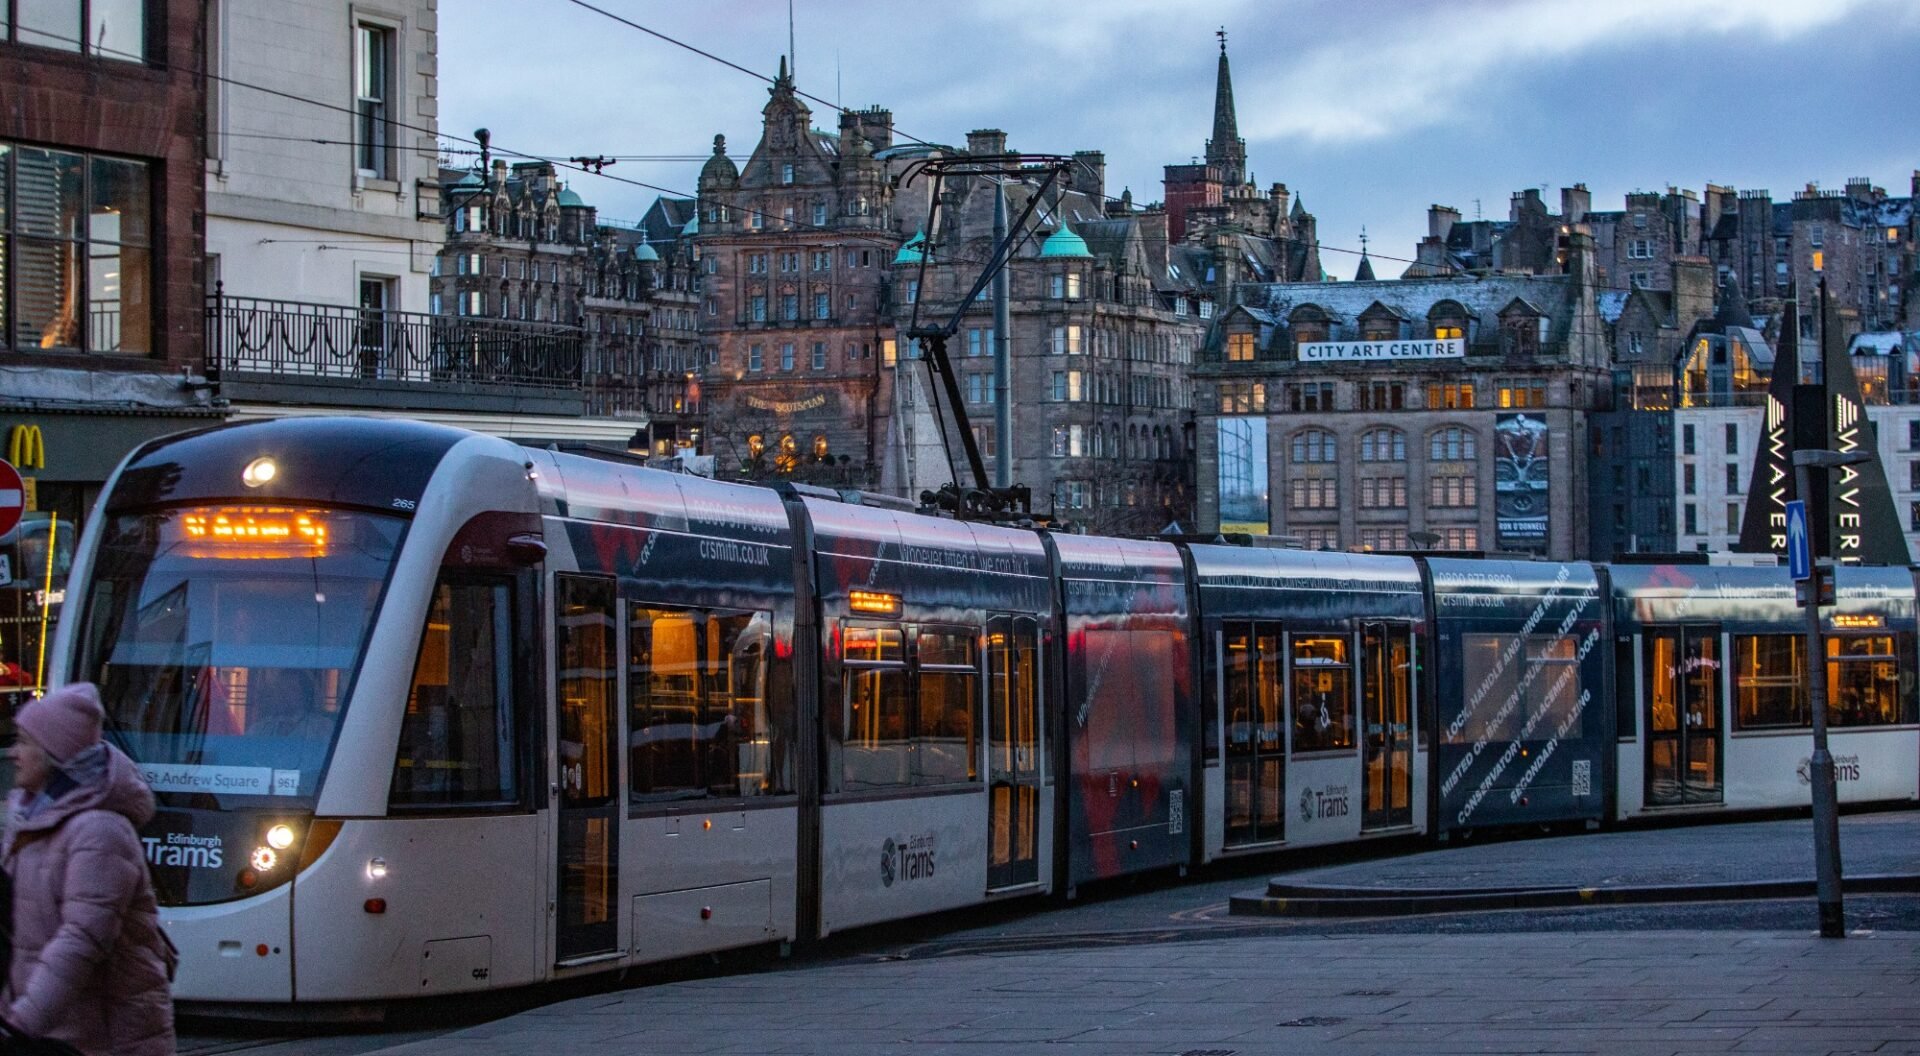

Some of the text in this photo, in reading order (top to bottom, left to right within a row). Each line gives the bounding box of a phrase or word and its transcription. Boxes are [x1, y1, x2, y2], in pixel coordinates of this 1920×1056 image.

[1307, 341, 1457, 358] CITY ART CENTRE
[775, 393, 825, 413] SCOTSMAN
[1769, 427, 1787, 549] WAVER
[392, 498, 416, 510] 265
[700, 539, 769, 566] crsmith.co.uk
[1470, 661, 1504, 710] HANDLE
[1503, 637, 1521, 665] AND
[1519, 609, 1546, 643] HINGE
[1458, 627, 1600, 824] CONSERVATORY REPLACEMENT OOFS
[1441, 752, 1474, 798] MISTED
[1473, 735, 1488, 756] OR
[1486, 692, 1520, 740] BROKEN
[1510, 688, 1591, 804] SECONDARY GLAZING
[146, 771, 259, 788] St Andrew Square
[277, 778, 295, 788] 961
[1834, 765, 1860, 781] ams
[1316, 792, 1348, 818] Trams
[142, 838, 223, 868] Trams
[166, 833, 222, 849] Edinburgh
[898, 843, 935, 881] Trams
